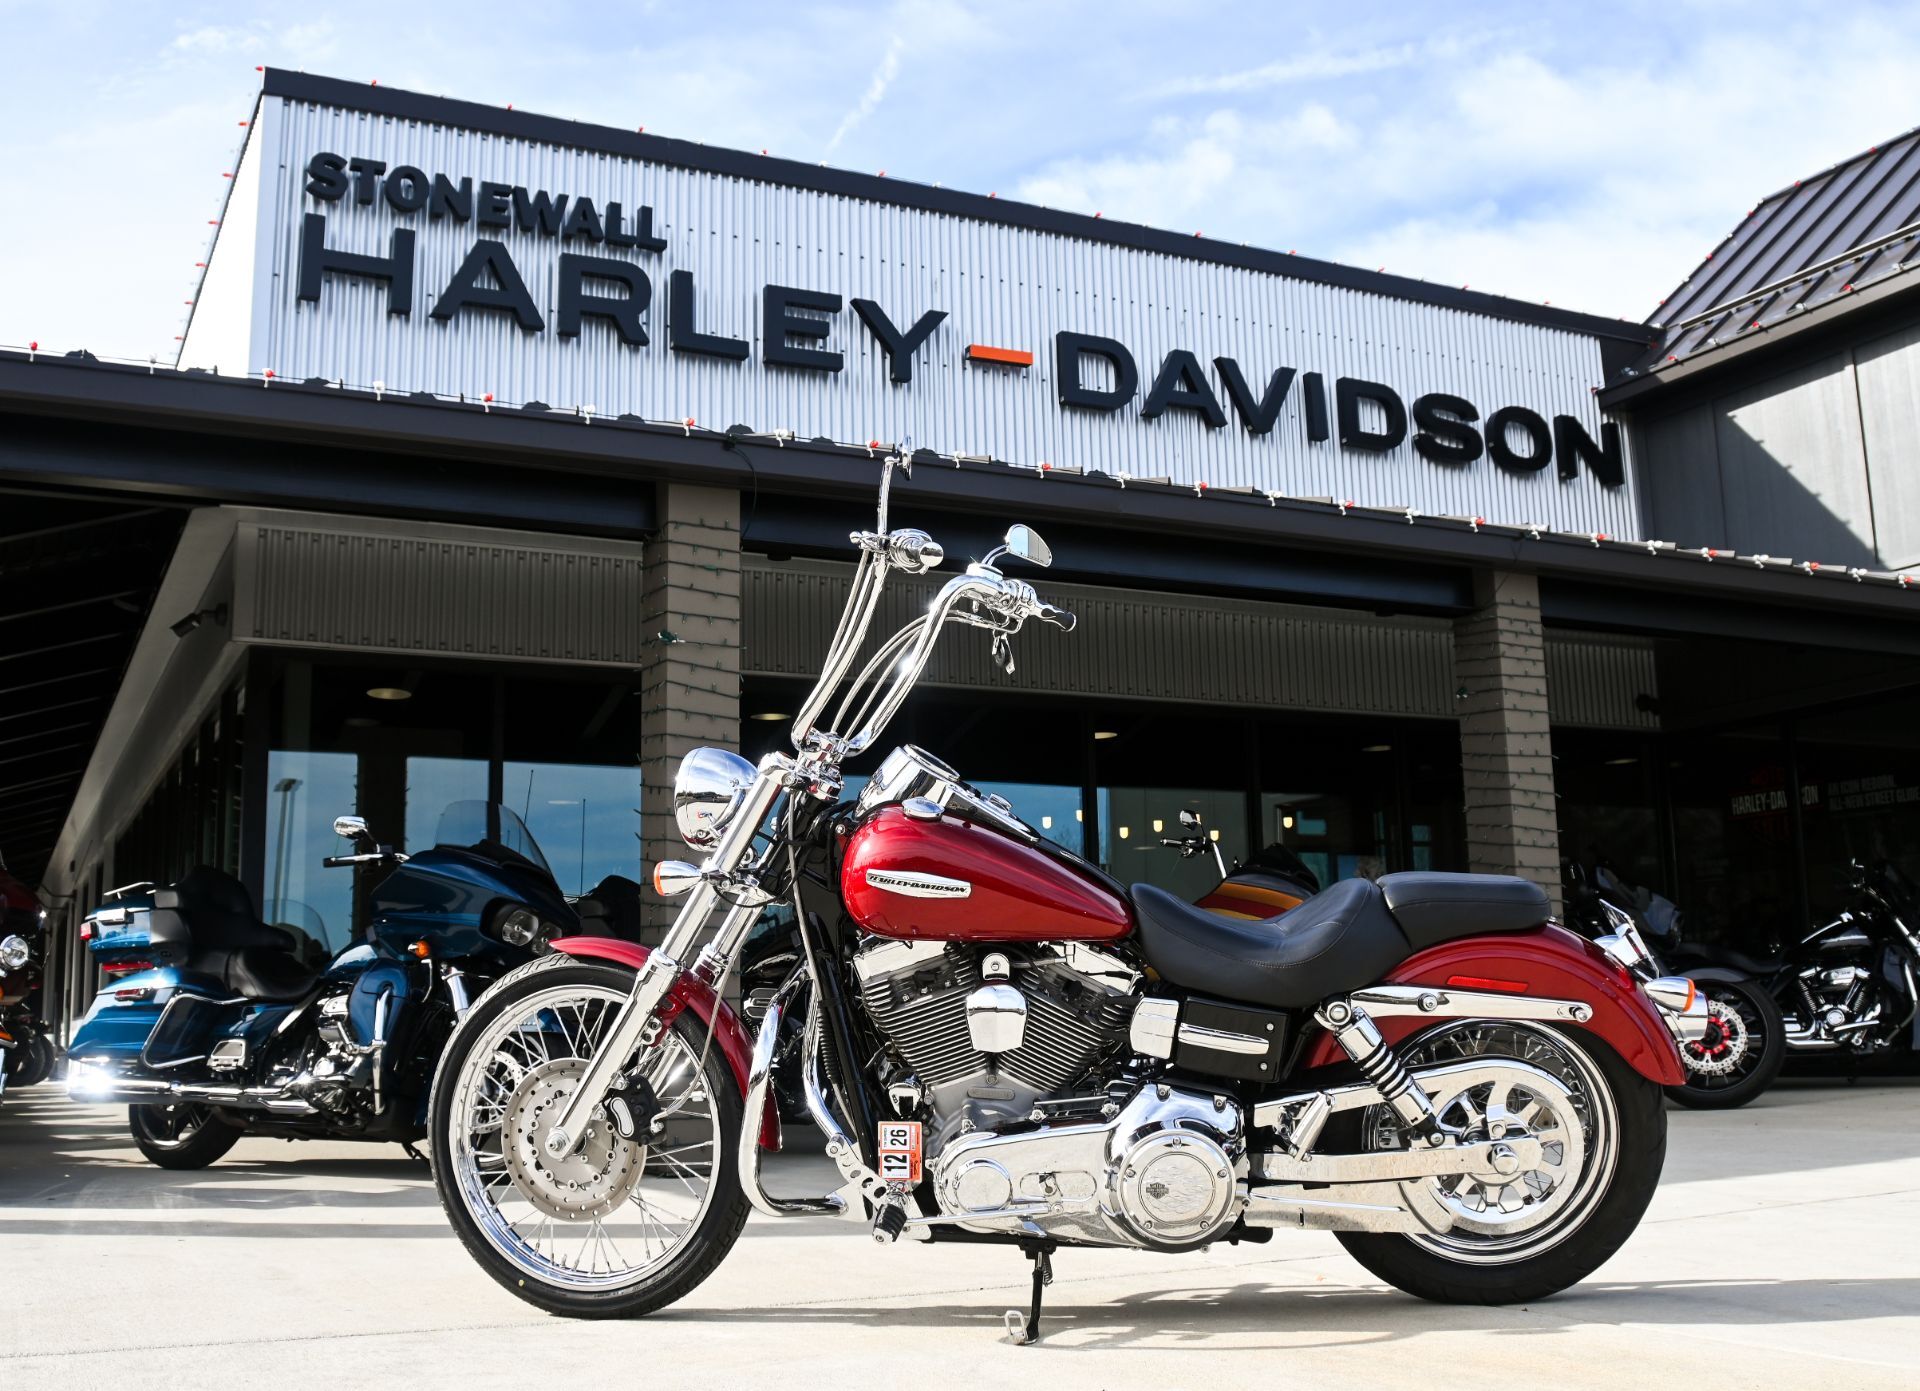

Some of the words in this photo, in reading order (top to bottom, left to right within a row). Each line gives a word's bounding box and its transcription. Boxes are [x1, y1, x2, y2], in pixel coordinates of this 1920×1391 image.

[305, 152, 668, 253] STONEWALL
[869, 875, 968, 893] HARLEY-DAVIDSON
[890, 1129, 907, 1146] 26
[884, 1154, 907, 1172] 12
